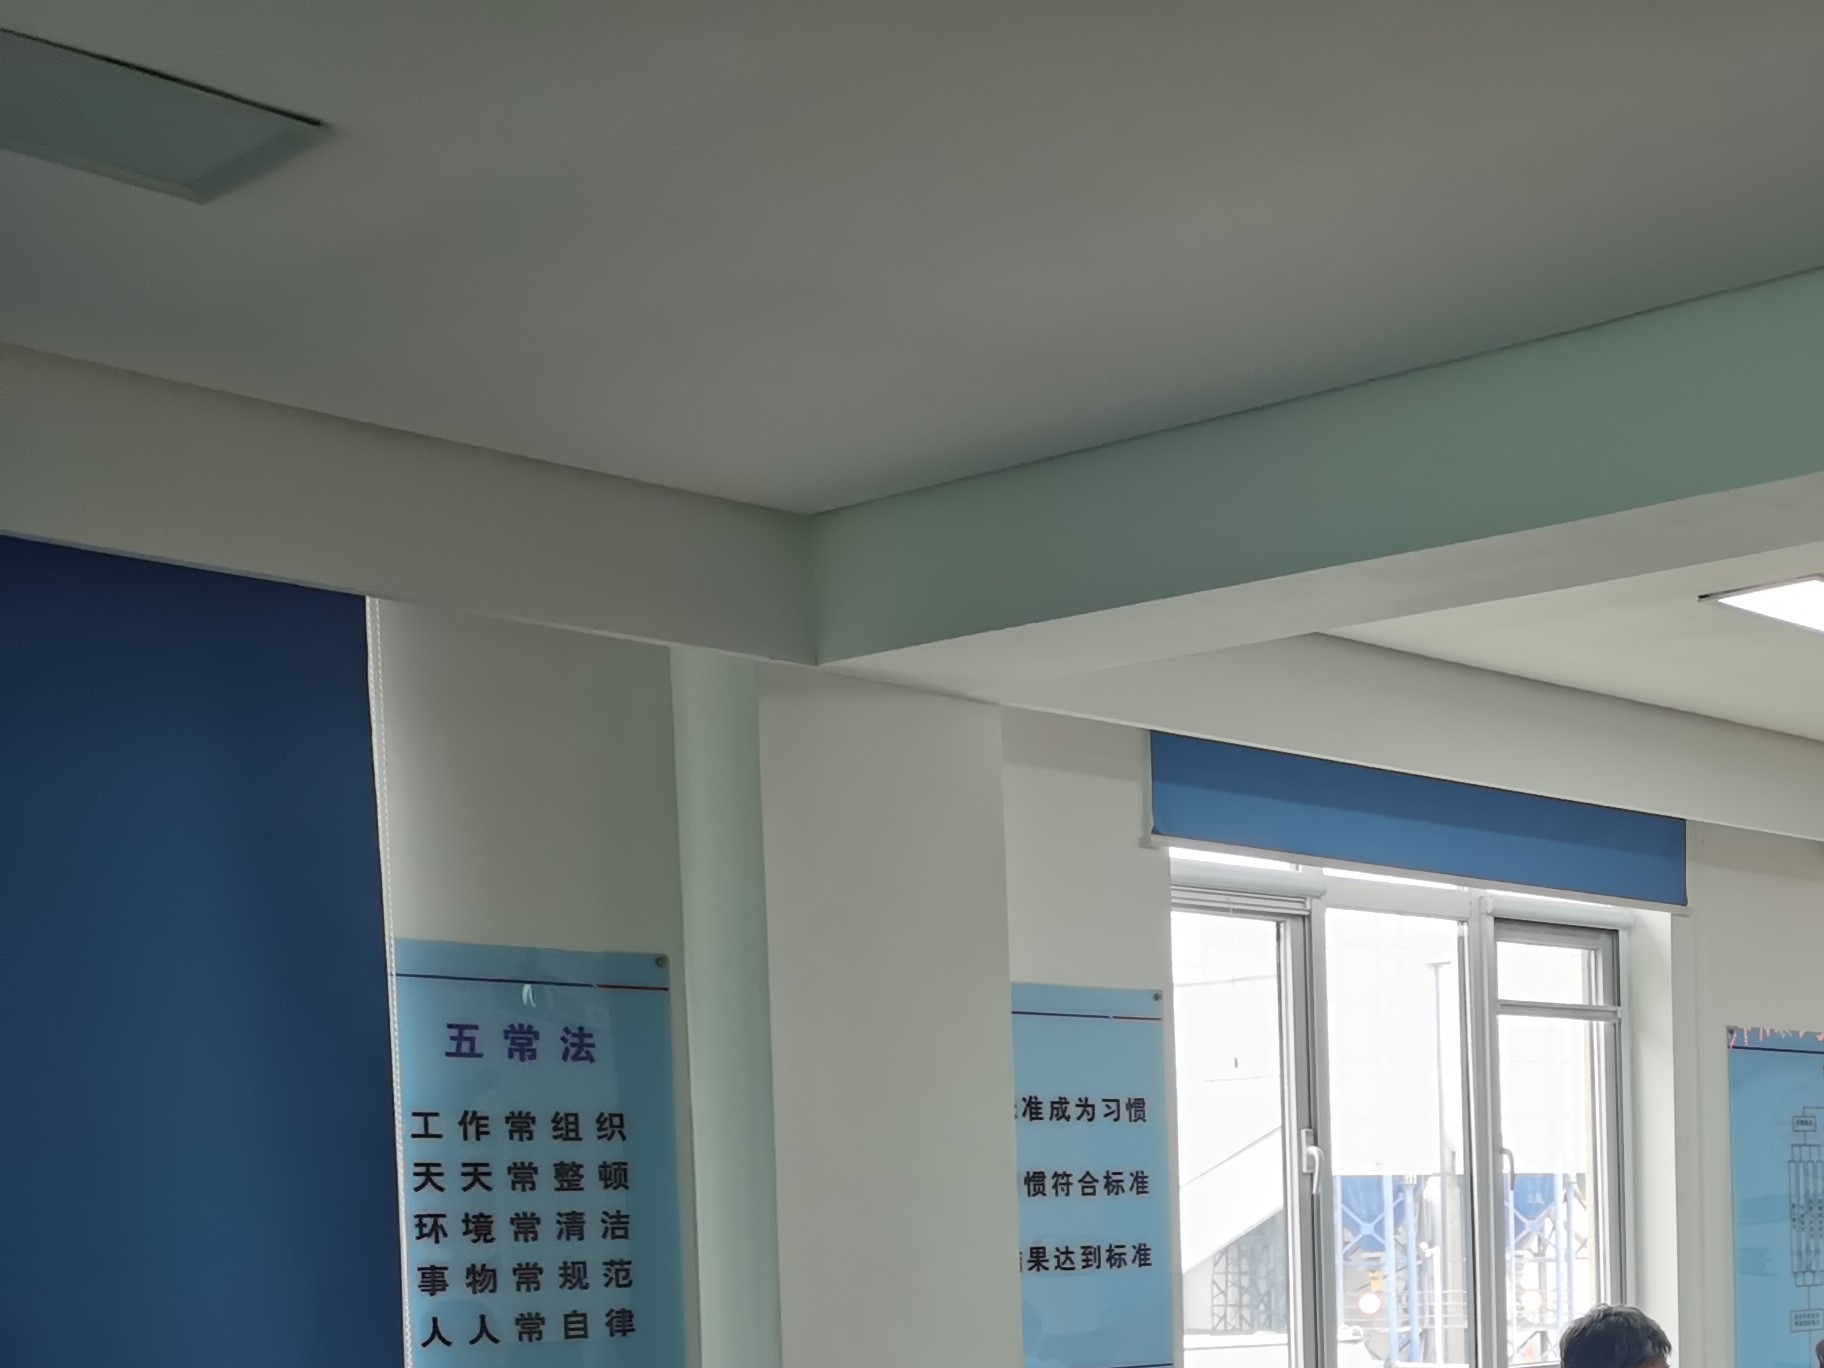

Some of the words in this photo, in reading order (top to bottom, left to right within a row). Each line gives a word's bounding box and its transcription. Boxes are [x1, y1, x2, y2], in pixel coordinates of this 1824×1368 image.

[445, 1023, 597, 1064] 五常法
[1016, 1095, 1147, 1124] 准成为习惯
[411, 1110, 627, 1142] 工作常组织
[412, 1161, 631, 1193] 天天常整顿
[1018, 1169, 1150, 1197] 惯符合标准
[414, 1210, 631, 1245] 环境常清洁
[1020, 1242, 1153, 1273] 果达到标准
[417, 1259, 634, 1297] 事物常规范
[420, 1307, 637, 1348] 人人常自律
